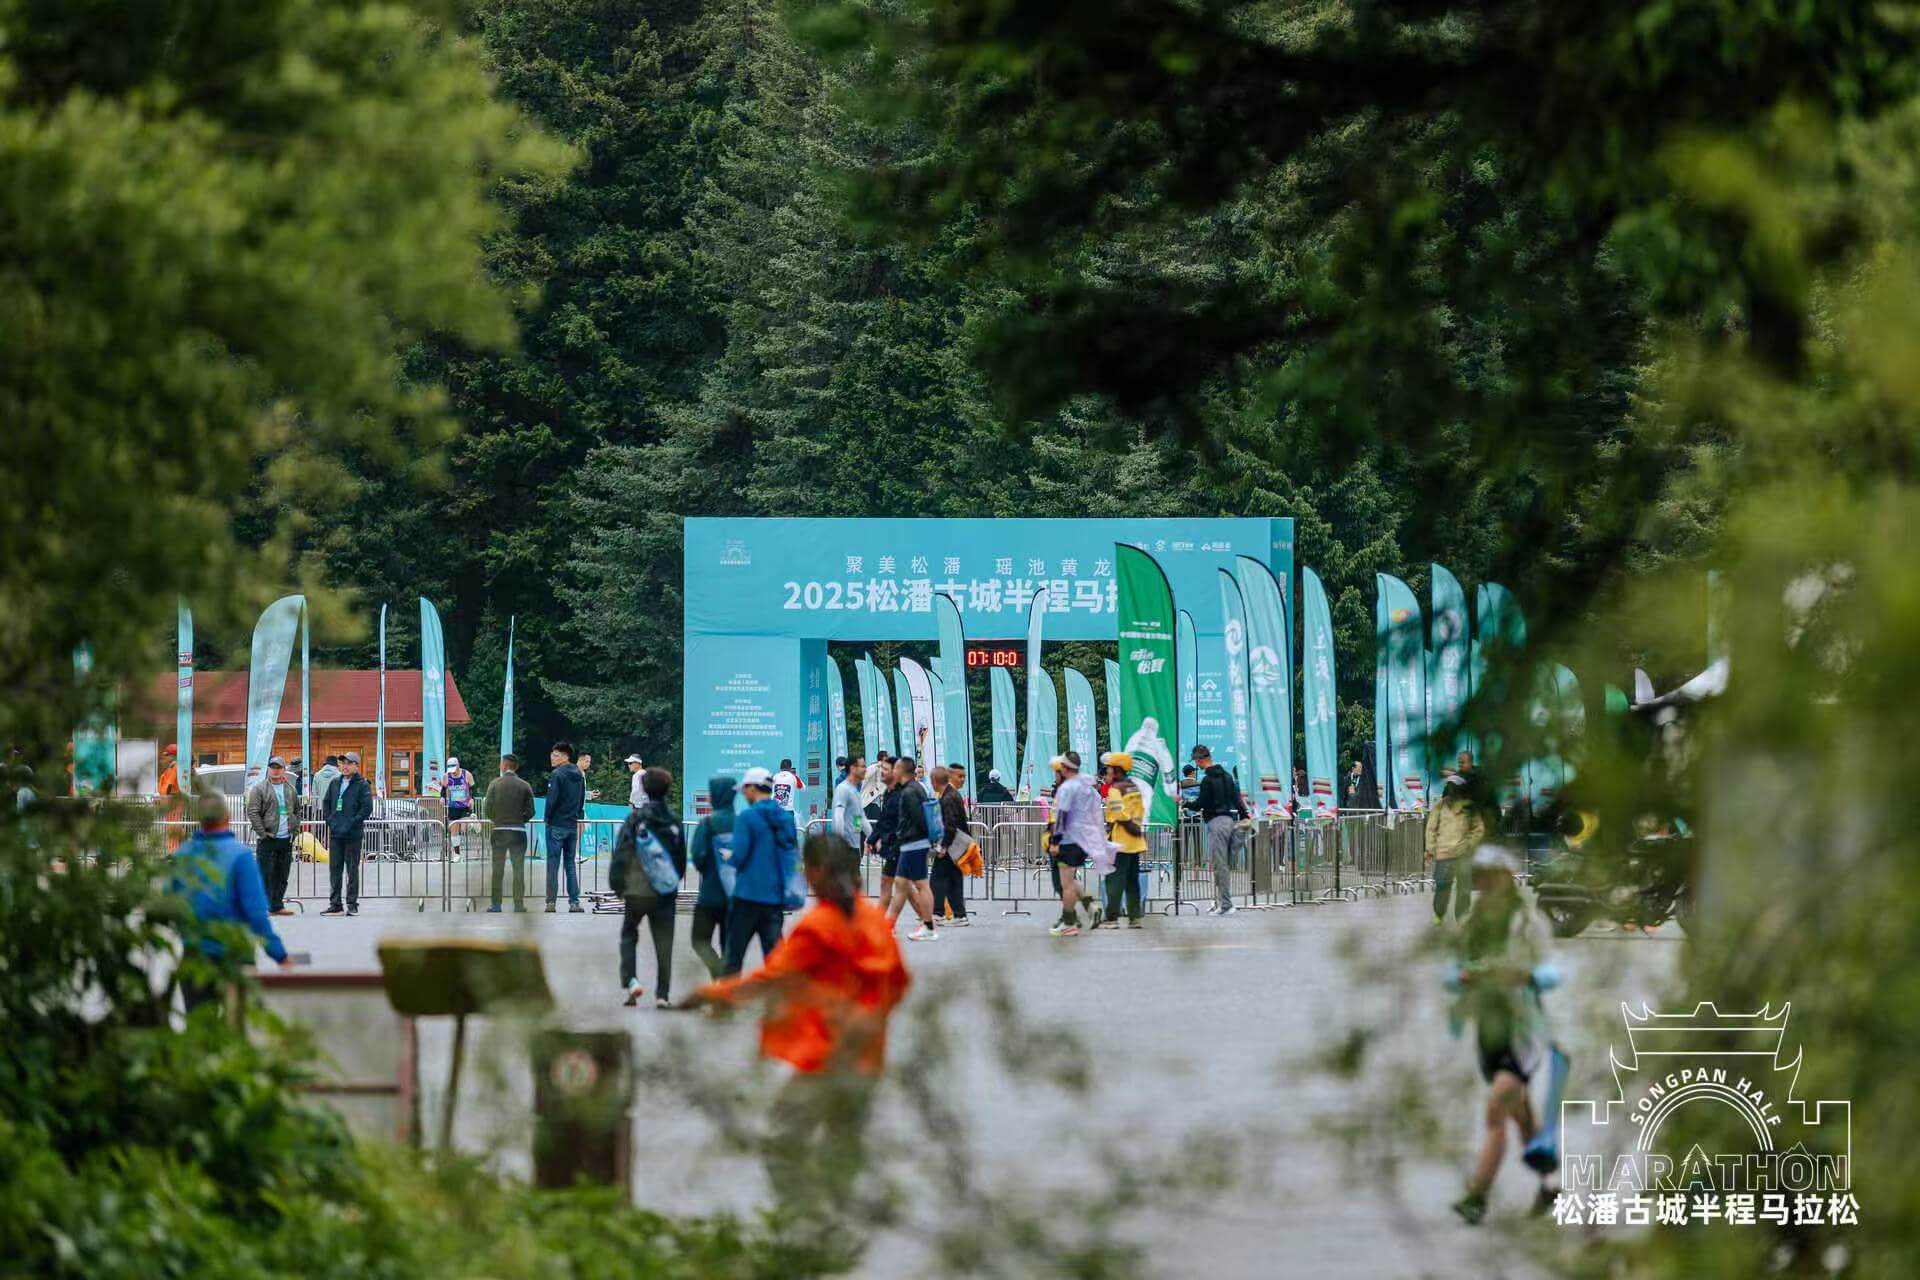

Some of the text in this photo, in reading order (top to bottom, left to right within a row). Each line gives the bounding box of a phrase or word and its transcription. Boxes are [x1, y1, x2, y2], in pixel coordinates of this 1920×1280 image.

[846, 555, 1112, 577] 聚美松潘 瑶池黄龙
